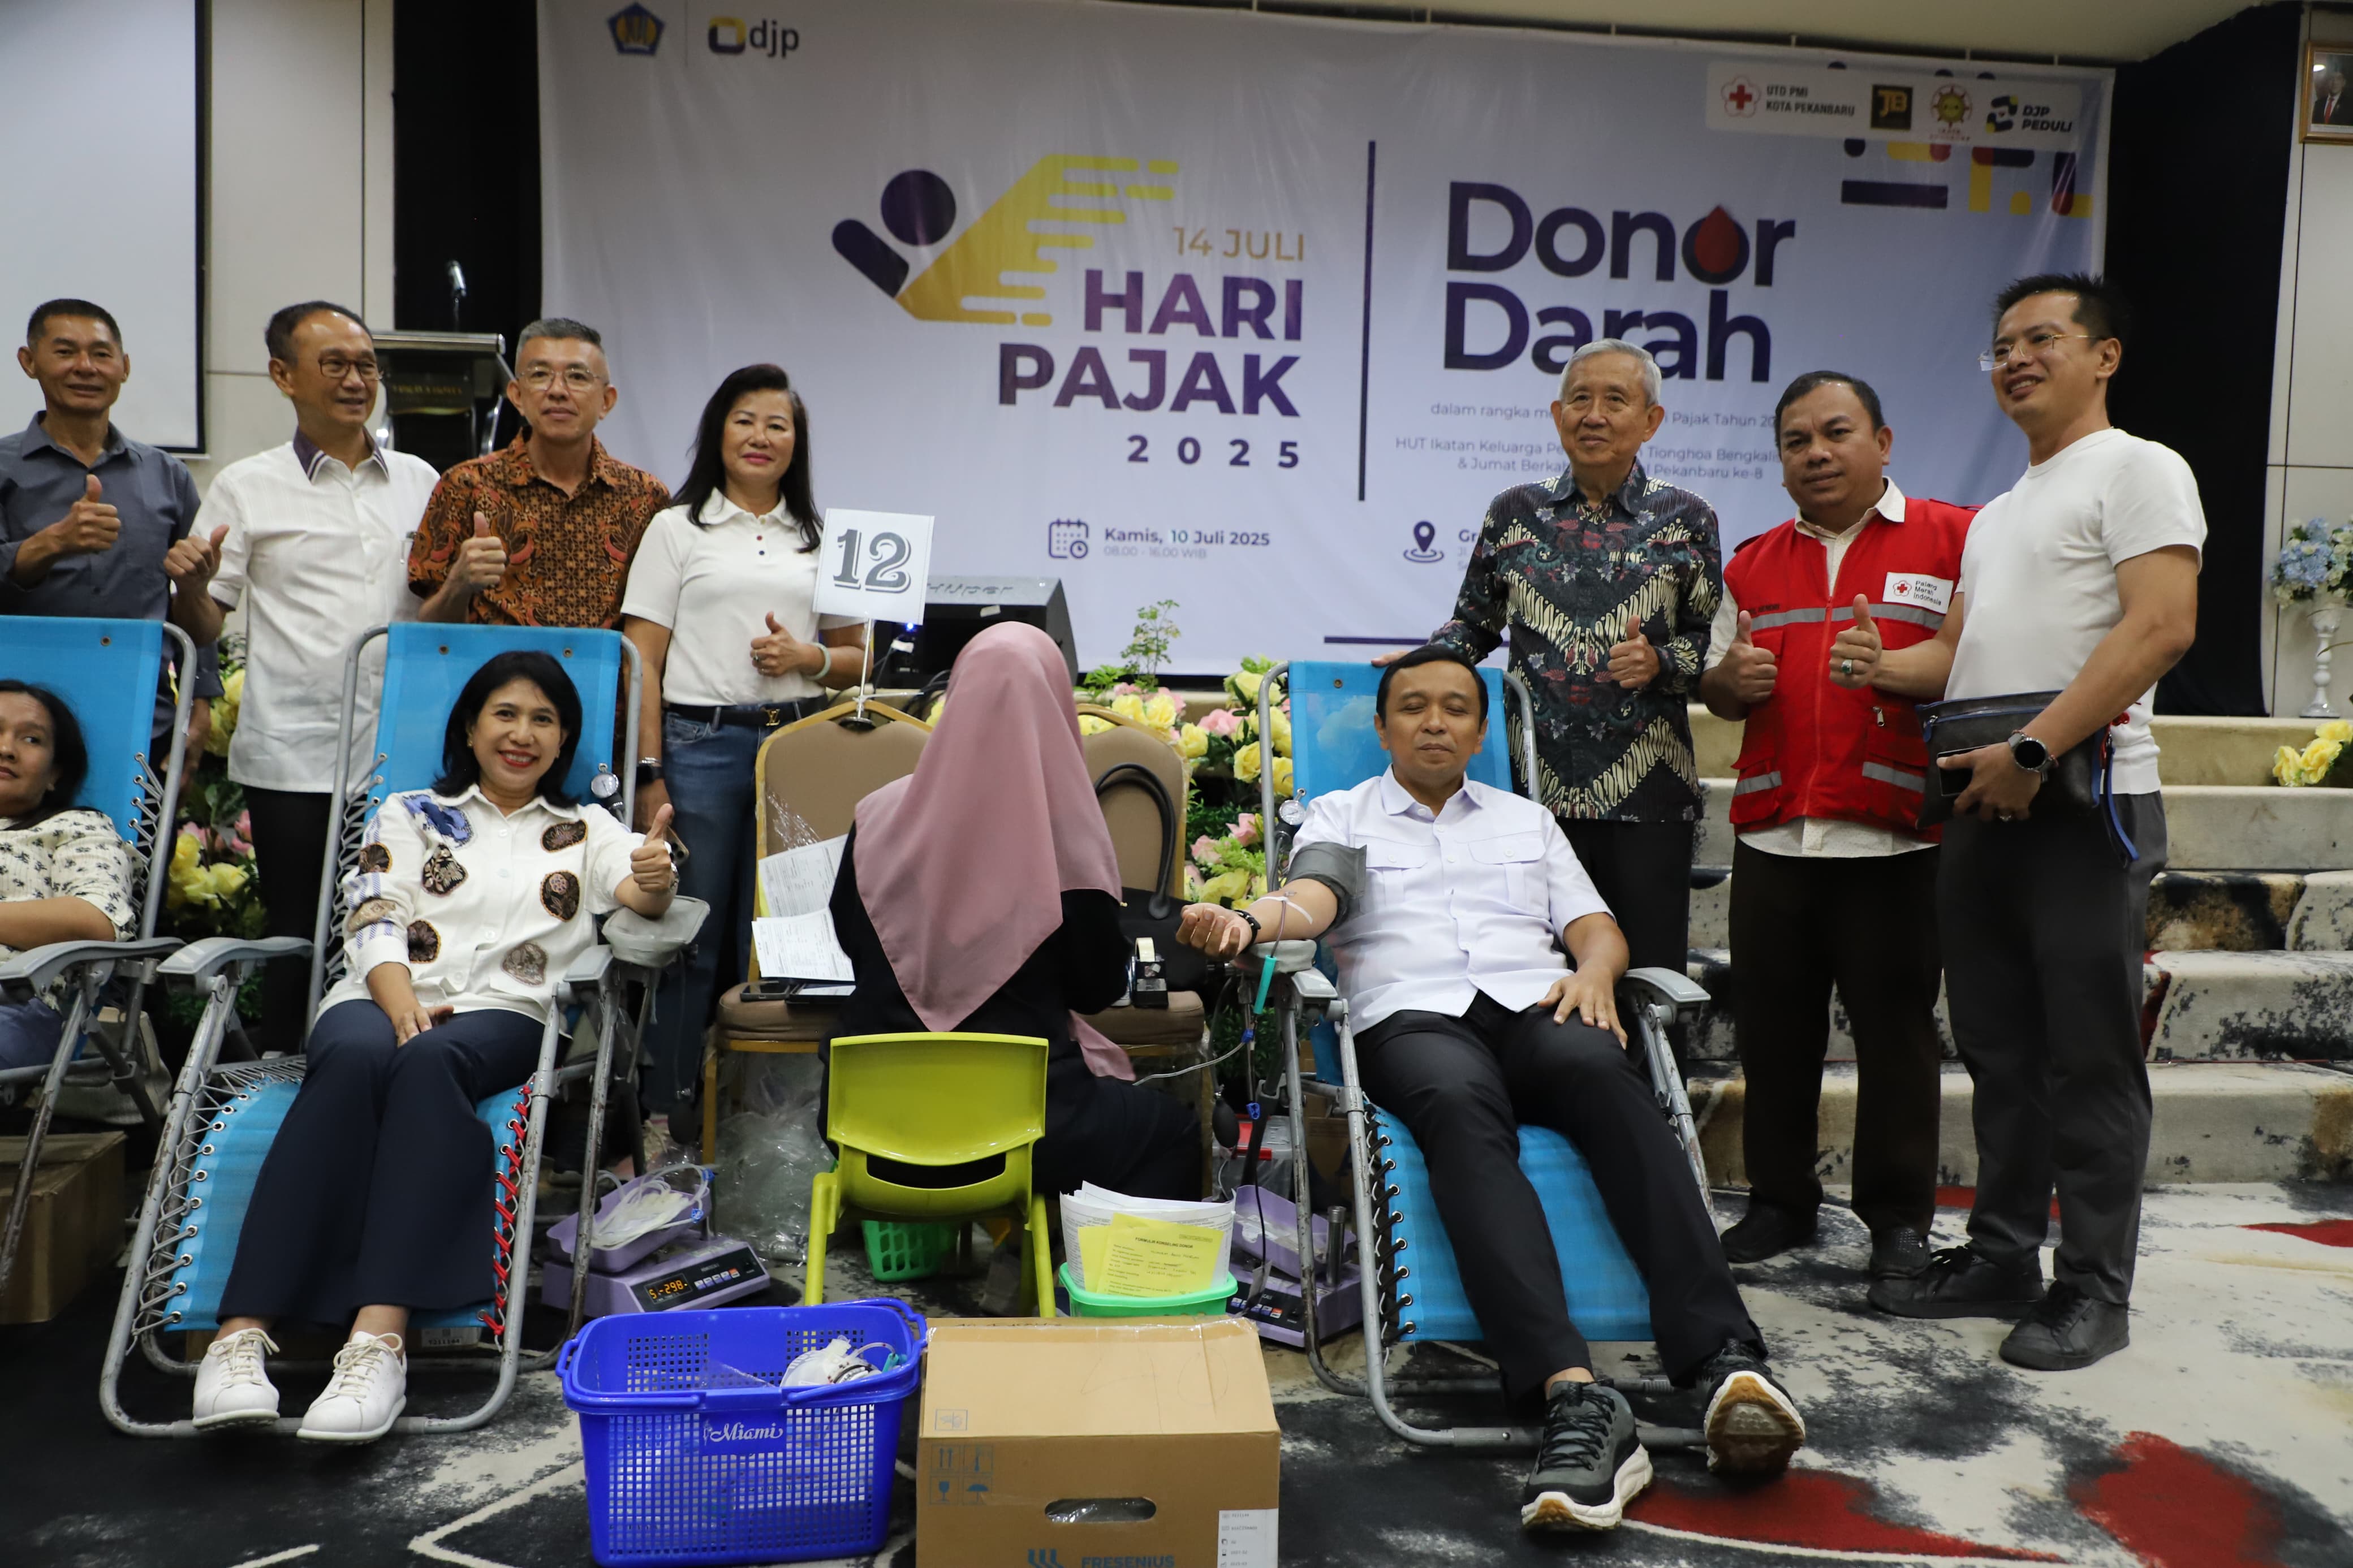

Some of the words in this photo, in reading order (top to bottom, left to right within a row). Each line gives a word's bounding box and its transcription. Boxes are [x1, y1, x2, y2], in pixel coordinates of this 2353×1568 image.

[749, 19, 799, 58] djp
[1766, 85, 1786, 96] UTD
[1789, 87, 1808, 97] PMI
[1766, 101, 1791, 112] KOTA
[1795, 103, 1855, 116] PEKANBARU
[2022, 105, 2050, 116] DJP
[2022, 118, 2072, 132] PEDULI
[1446, 180, 1796, 287] Donor
[1173, 227, 1213, 257] 14
[1222, 229, 1304, 261] JULI
[1084, 269, 1303, 341] HARI
[998, 343, 1300, 417] PAJAK
[1430, 403, 1476, 416] dalam
[1480, 405, 1530, 420] rangka
[1673, 412, 1709, 427] Pajak
[1714, 413, 1756, 426] Tahun
[1395, 437, 1427, 450] HUT
[1430, 438, 1475, 452] Ikatan
[1480, 440, 1542, 455] Keluarga
[1648, 446, 1712, 461] Tionghoa
[1458, 457, 1467, 469] &
[1471, 457, 1516, 471] Jumat
[1654, 465, 1729, 478] Pekanbaru
[1105, 528, 1163, 545] Kamis,
[1171, 529, 1188, 543] 10
[1193, 530, 1224, 545] Juli
[1230, 532, 1270, 546] 2025
[833, 528, 912, 594] 12
[1915, 580, 1937, 590] Palang
[1915, 586, 1933, 595] Merah
[1914, 593, 1941, 606] Indonesia
[710, 1422, 783, 1442] Miami
[1081, 1554, 1175, 1568] FRESENIUS
